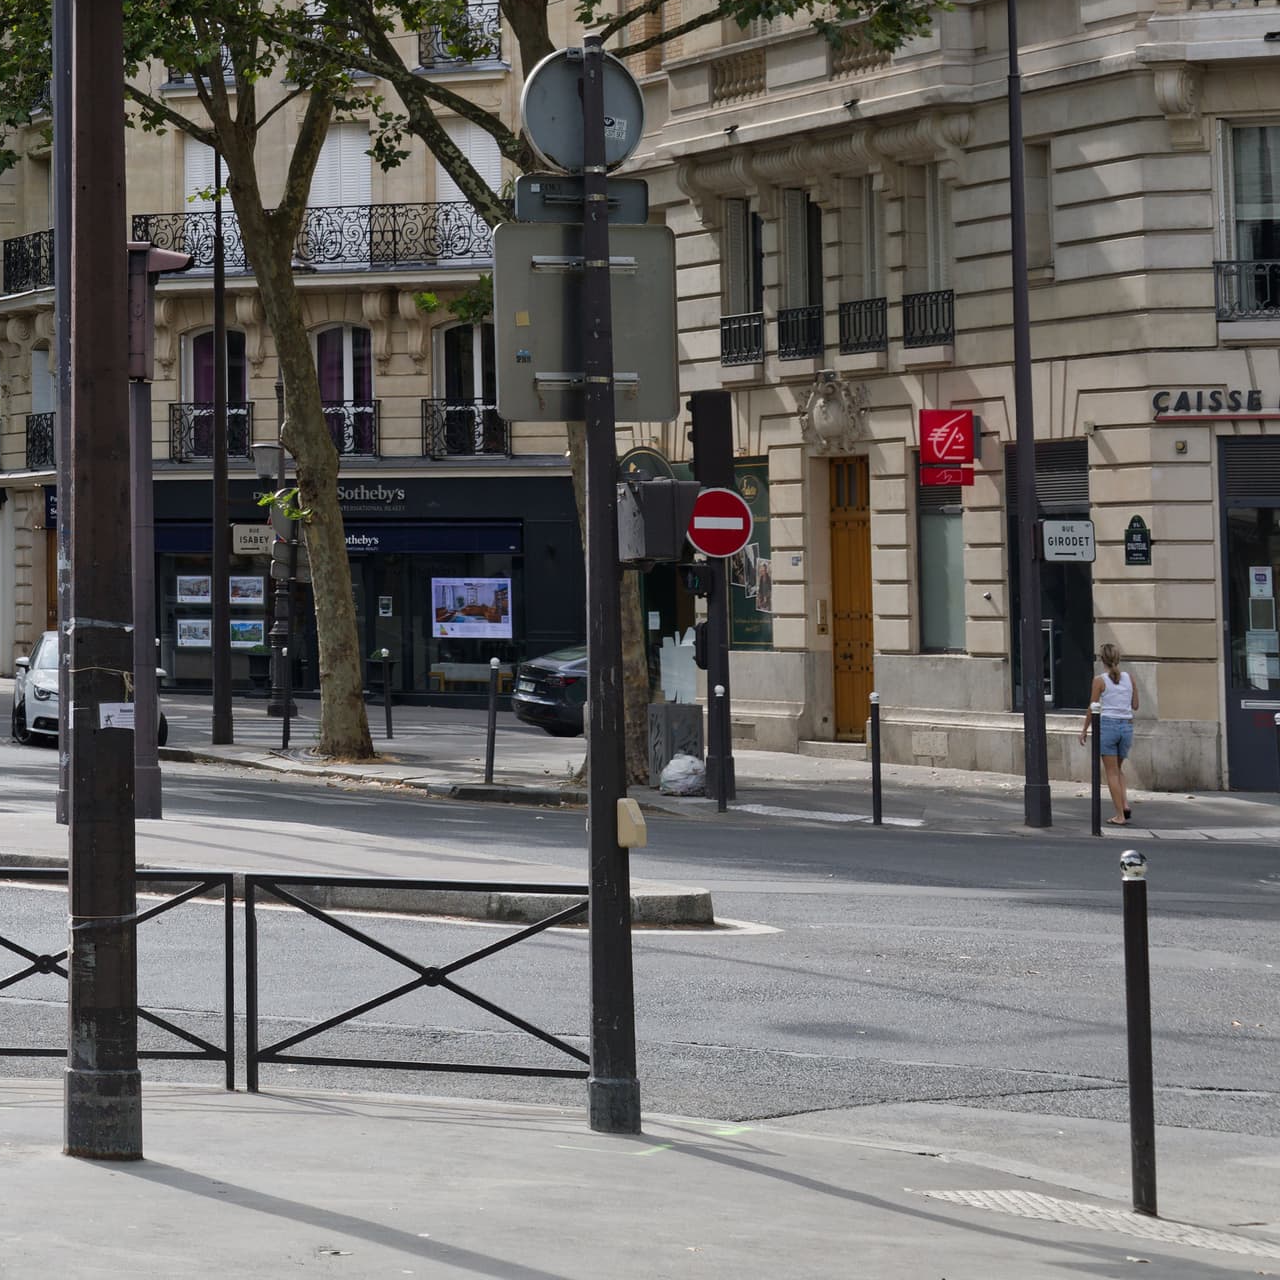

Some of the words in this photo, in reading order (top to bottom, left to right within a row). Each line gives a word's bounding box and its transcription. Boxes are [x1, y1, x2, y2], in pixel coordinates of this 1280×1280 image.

[1152, 389, 1263, 413] CAISSE
[337, 484, 406, 503] Sotheby's
[1061, 525, 1075, 533] RUE
[240, 535, 270, 544] ISABEY
[344, 534, 379, 547] otheby's
[1047, 536, 1090, 547] GIRODET
